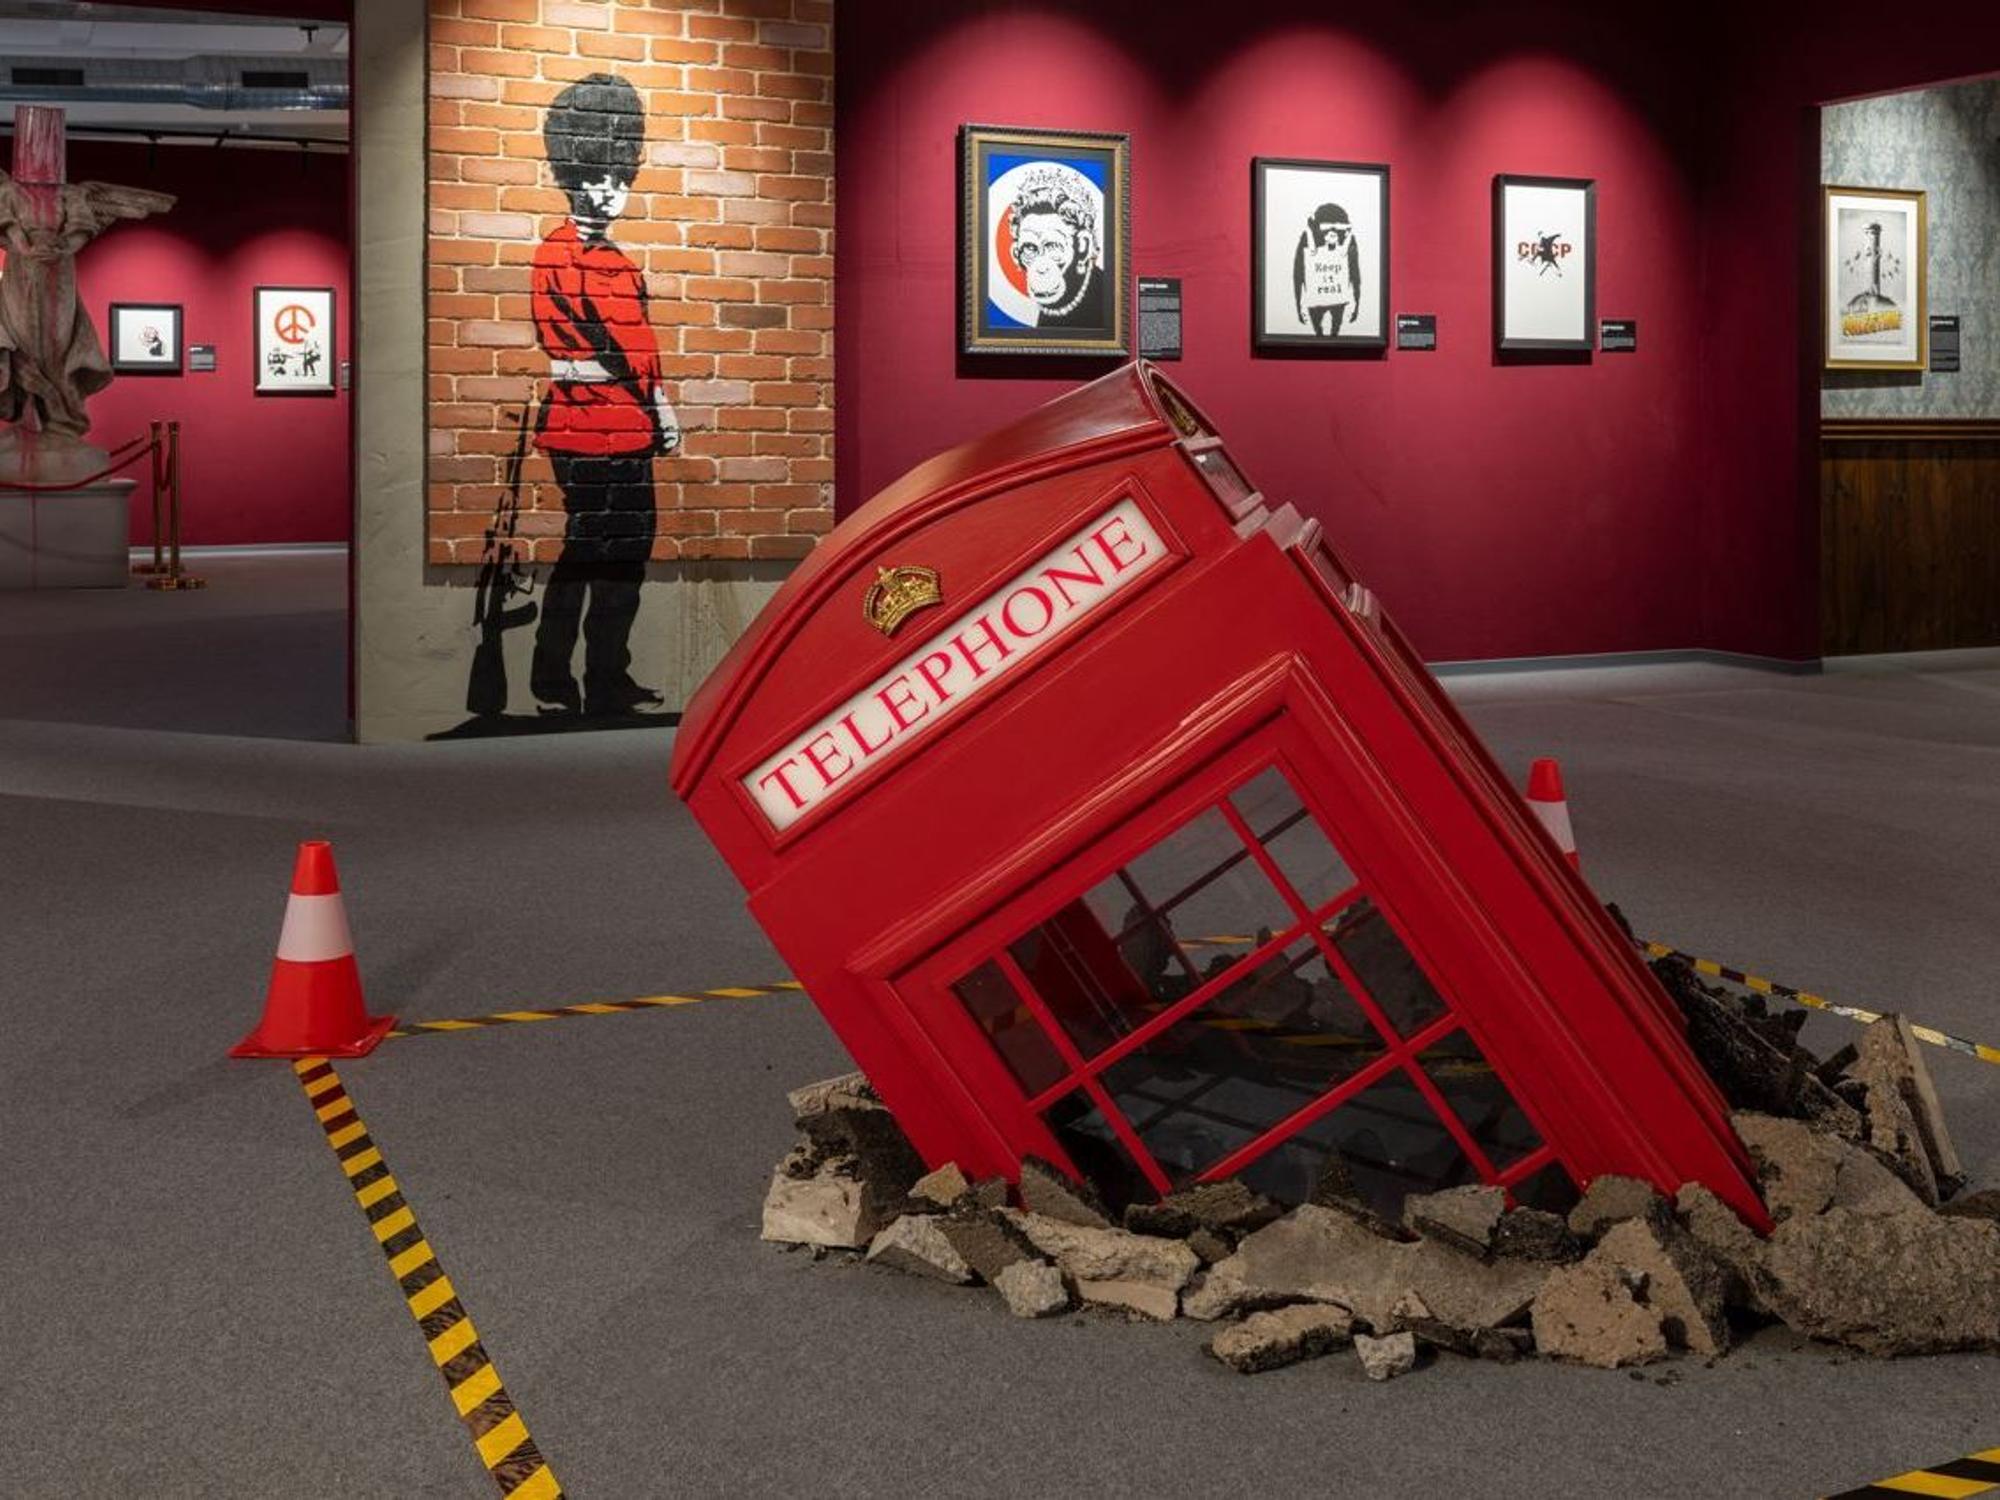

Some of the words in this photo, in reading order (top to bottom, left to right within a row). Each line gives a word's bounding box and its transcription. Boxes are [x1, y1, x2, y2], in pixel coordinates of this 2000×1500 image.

[1314, 262, 1342, 274] Keep
[1322, 274, 1335, 283] it
[1317, 283, 1342, 294] real
[759, 516, 1147, 809] TELEPHONE
